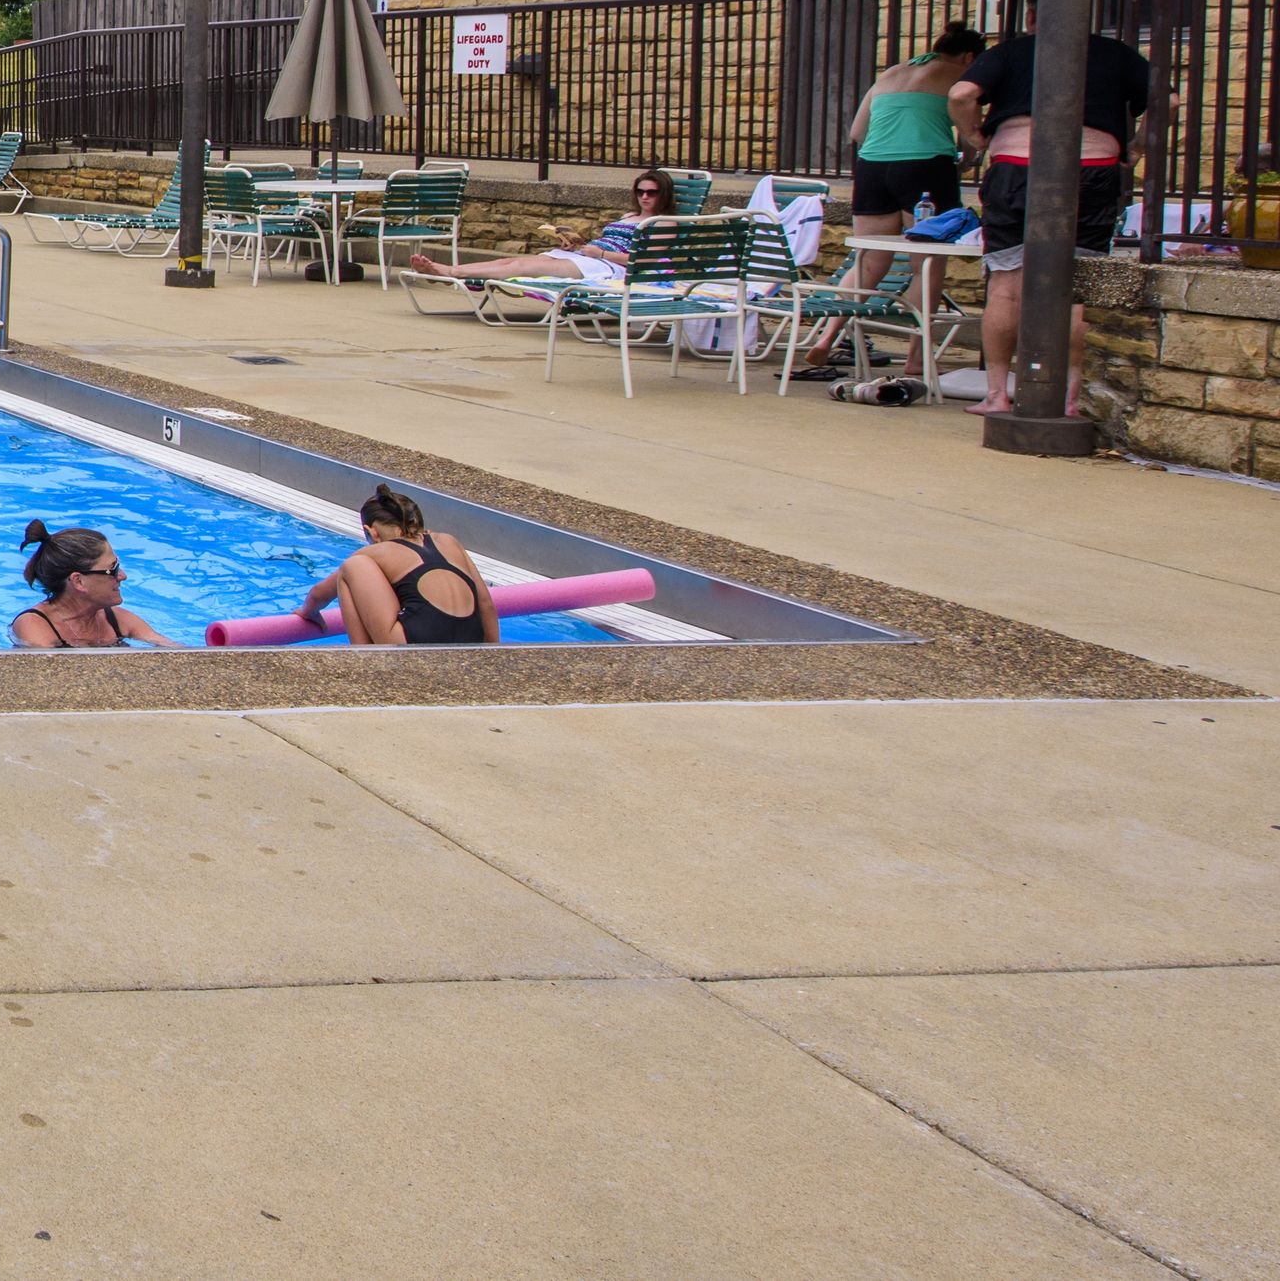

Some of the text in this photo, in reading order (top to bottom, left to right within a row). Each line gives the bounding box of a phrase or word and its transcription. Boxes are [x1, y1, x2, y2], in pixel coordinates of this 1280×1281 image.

[474, 23, 487, 31] NO
[457, 35, 504, 44] LIFEGUARD
[473, 47, 485, 56] ON
[468, 59, 490, 68] DUTY
[165, 417, 173, 441] 5
